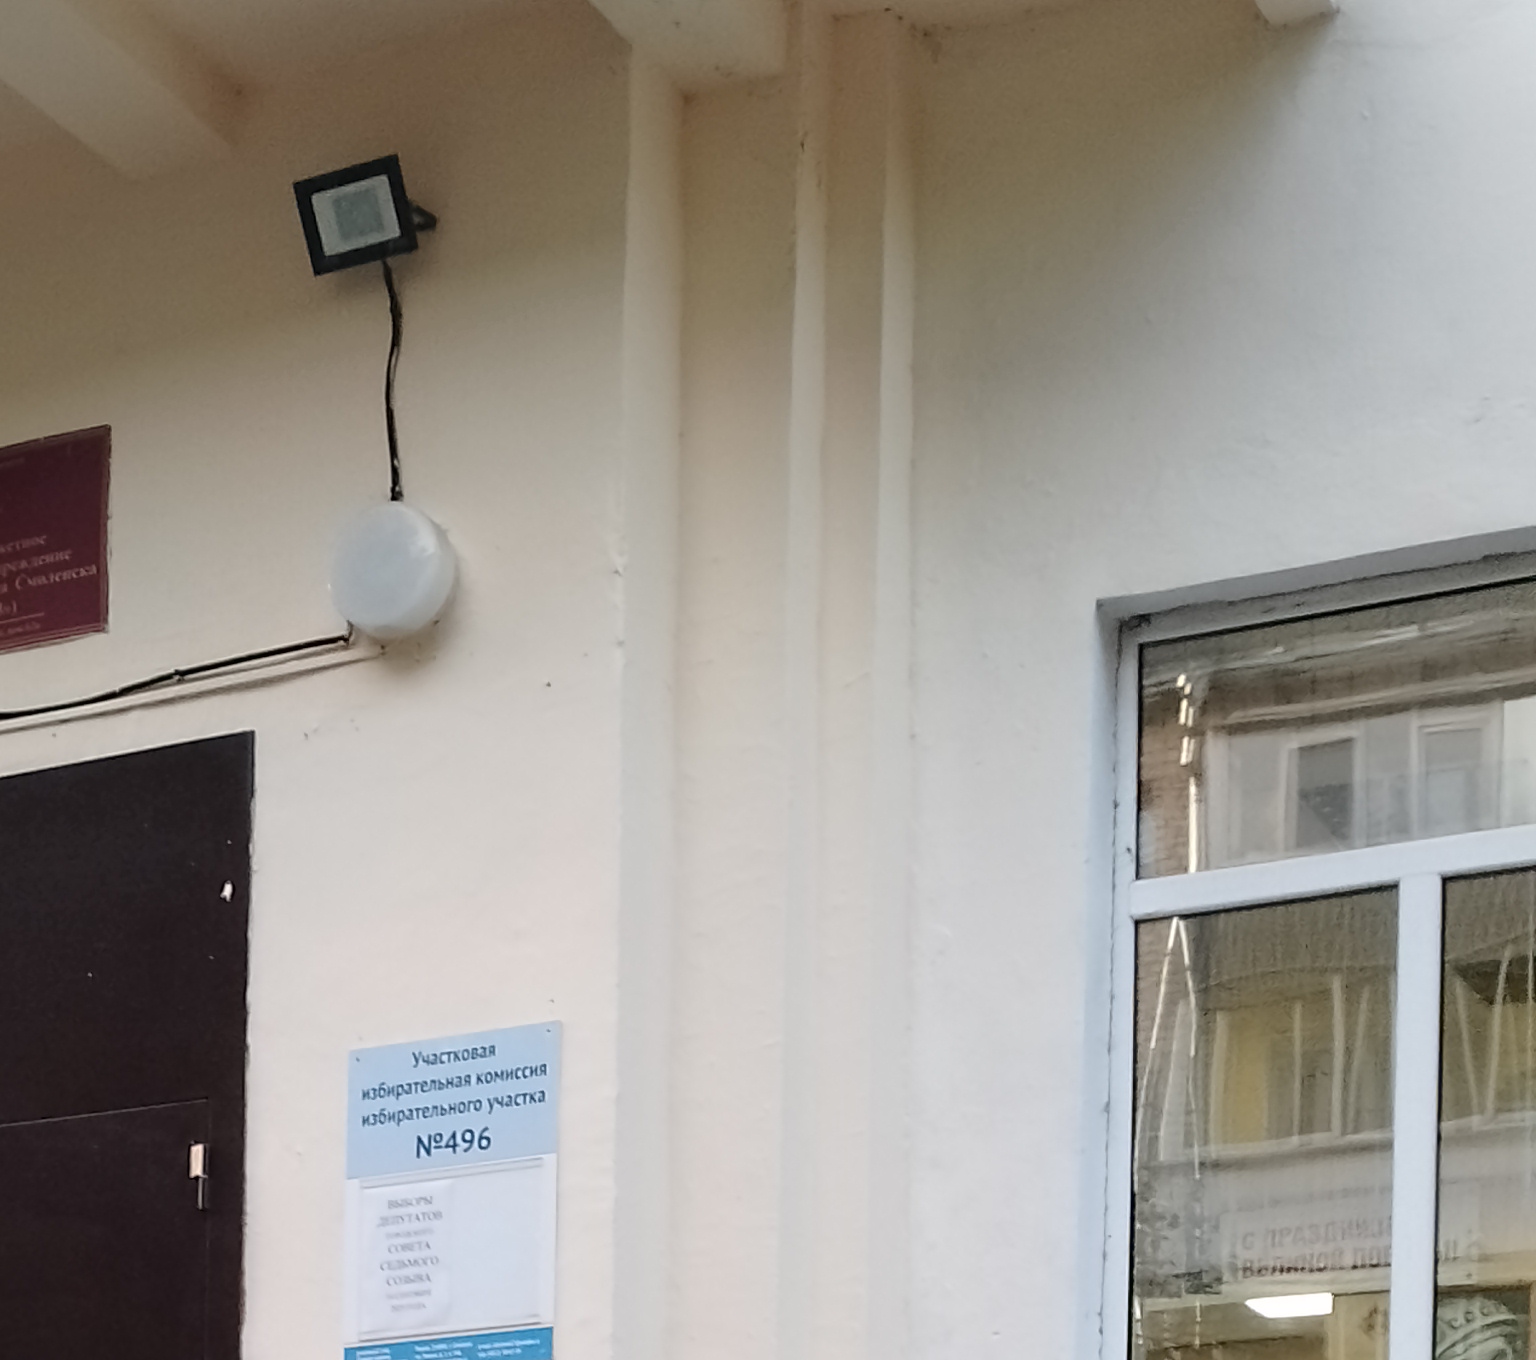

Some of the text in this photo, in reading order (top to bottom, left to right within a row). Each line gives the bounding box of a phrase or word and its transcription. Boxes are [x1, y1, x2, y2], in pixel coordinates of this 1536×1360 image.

[412, 1044, 496, 1068] Участковая
[361, 1062, 547, 1101] избирательная комиссия
[361, 1089, 546, 1127] избирательного участка
[416, 1126, 491, 1158] №496
